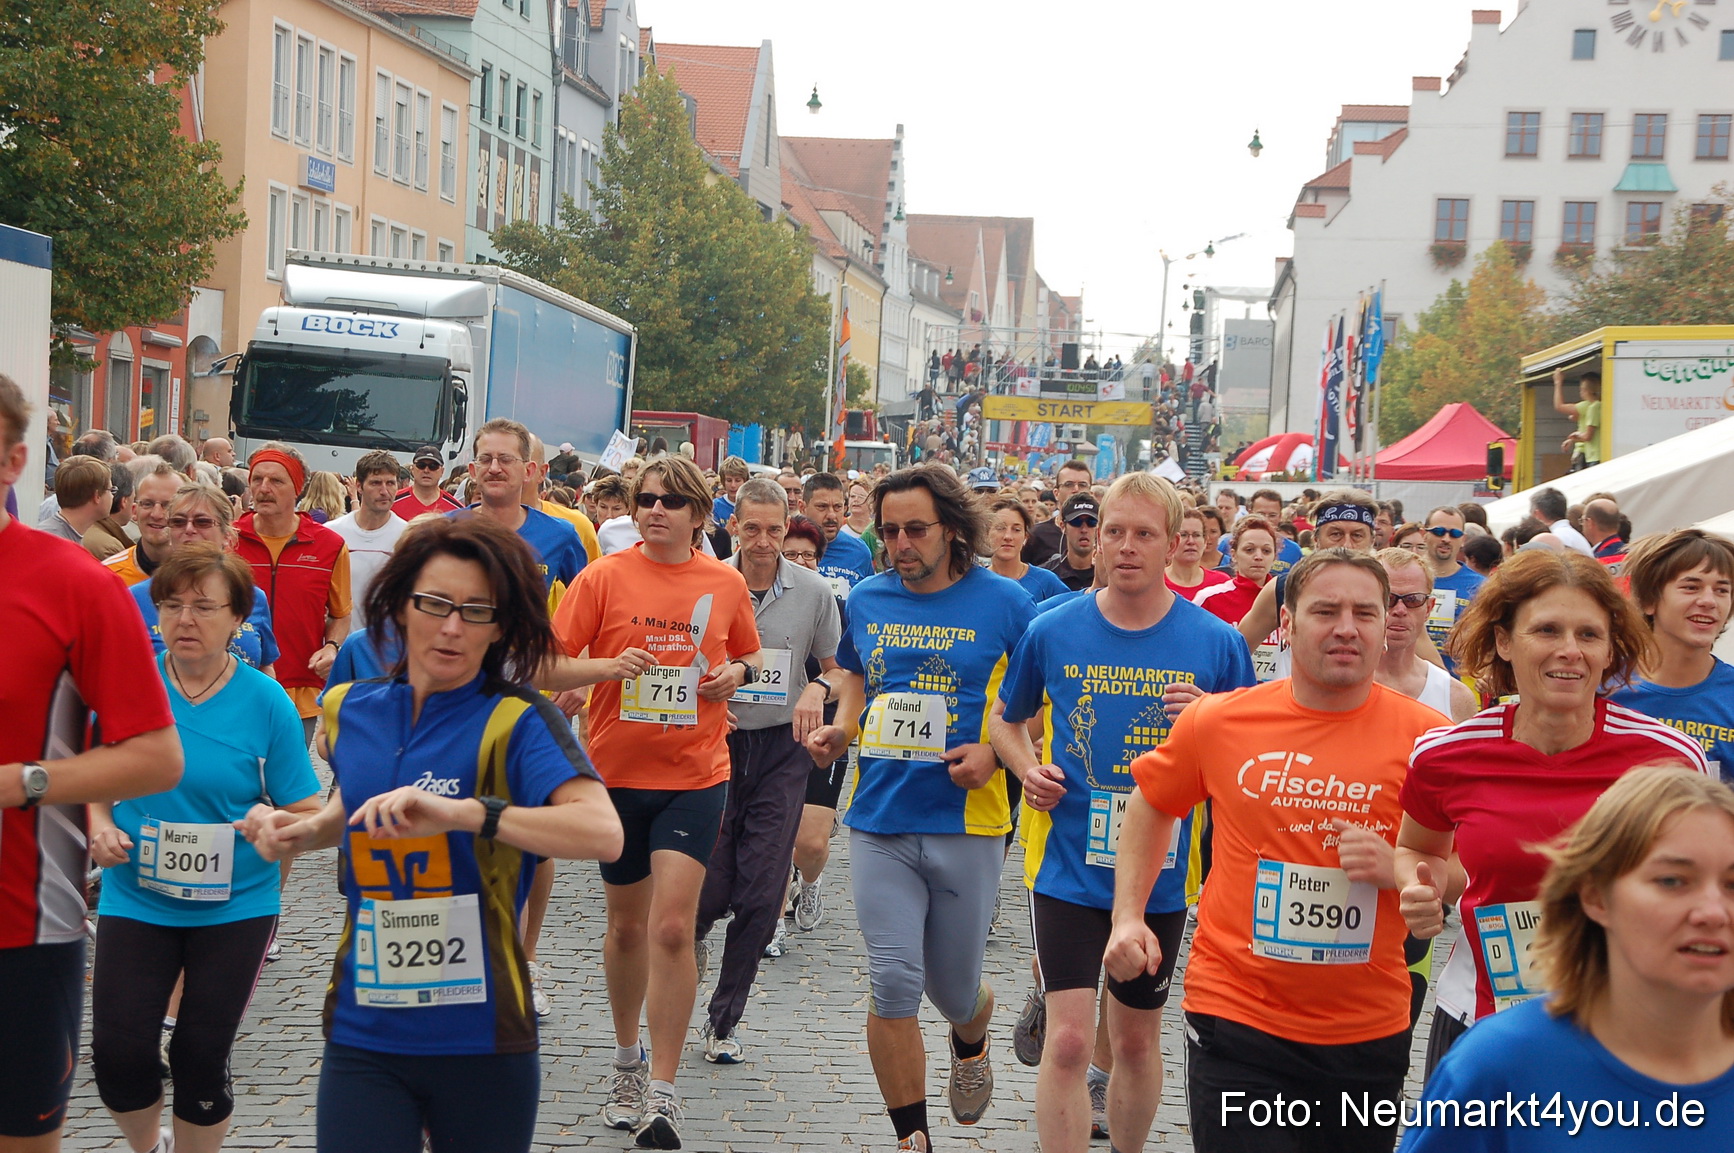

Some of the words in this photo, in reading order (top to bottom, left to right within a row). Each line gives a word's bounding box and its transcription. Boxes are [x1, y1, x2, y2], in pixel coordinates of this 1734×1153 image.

[301, 314, 400, 339] BOCK
[1037, 403, 1096, 419] START
[630, 616, 641, 626] 4.
[645, 617, 667, 629] Mai
[670, 621, 700, 635] 2008
[866, 623, 880, 635] 10.
[883, 623, 976, 642] NEUMARKTER
[645, 634, 667, 643] Maxi
[668, 634, 686, 642] DSL
[648, 642, 694, 652] Marathon
[877, 634, 954, 651] STADTLAUF
[1063, 664, 1083, 678] 10.
[1086, 664, 1195, 685] NEUMARKTER
[1253, 661, 1276, 673] 774
[651, 684, 687, 703] 715
[1082, 679, 1166, 698] STADTLAU
[887, 697, 922, 713] Roland
[668, 713, 696, 721] PFLEIDERER
[893, 719, 932, 739] 714
[1260, 769, 1382, 801] Fischer
[1271, 796, 1371, 814] AUTOMOBILE
[1289, 819, 1315, 833] und
[164, 829, 198, 844] Maria
[143, 845, 150, 856] D
[164, 851, 220, 873] 3001
[1289, 872, 1330, 893] Peter
[193, 888, 229, 896] PFLEIDERER
[1261, 895, 1269, 909] D
[381, 909, 440, 929] Simone
[1288, 901, 1362, 930] 3590
[386, 937, 467, 969] 3292
[1325, 948, 1368, 958] PFLEIDERER
[1492, 944, 1502, 960] D
[433, 986, 483, 997] PFLEIDERER
